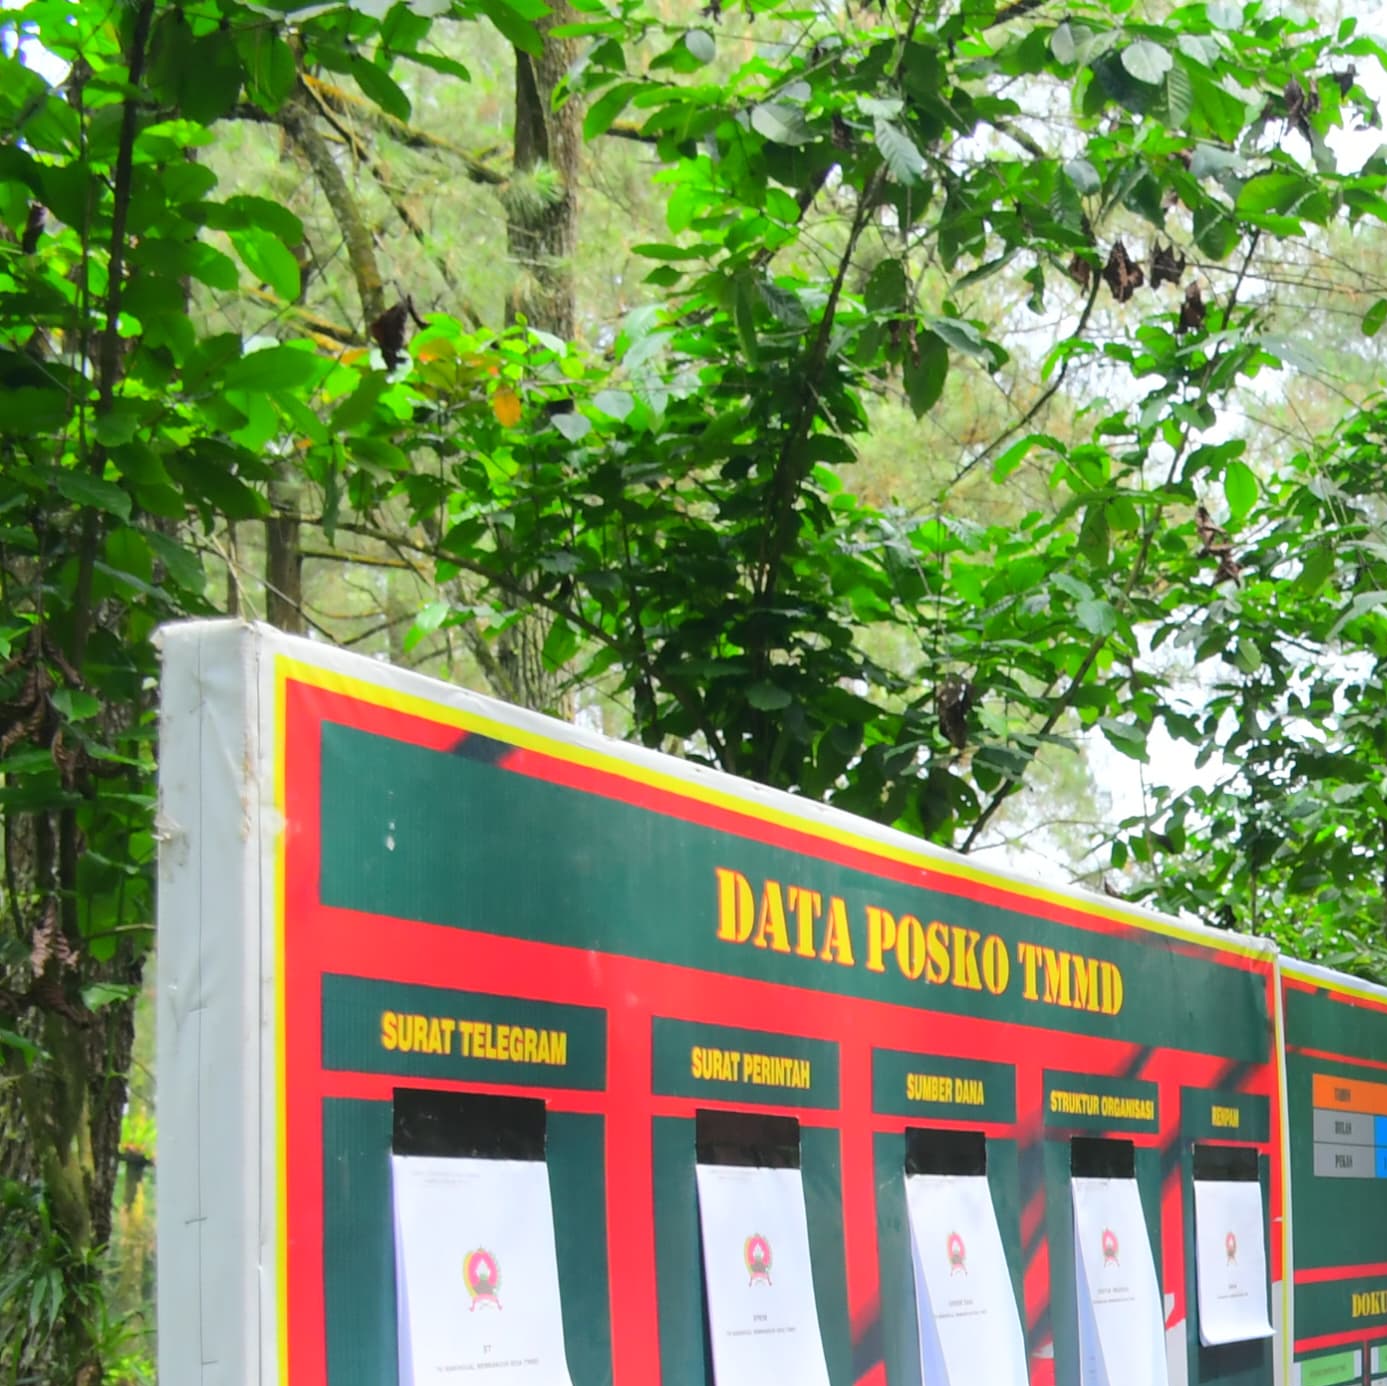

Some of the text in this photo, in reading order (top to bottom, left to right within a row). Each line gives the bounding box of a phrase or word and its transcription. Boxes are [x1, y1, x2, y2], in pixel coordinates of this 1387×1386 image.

[714, 867, 1124, 1016] DATA POSKO TMMD
[381, 1011, 567, 1066] SURAT TELEGRAM
[691, 1046, 810, 1089] SURAT PERINTAH
[906, 1073, 984, 1105] SUMBER DANA
[1050, 1090, 1154, 1120] STRUKTUR ORGANISASI
